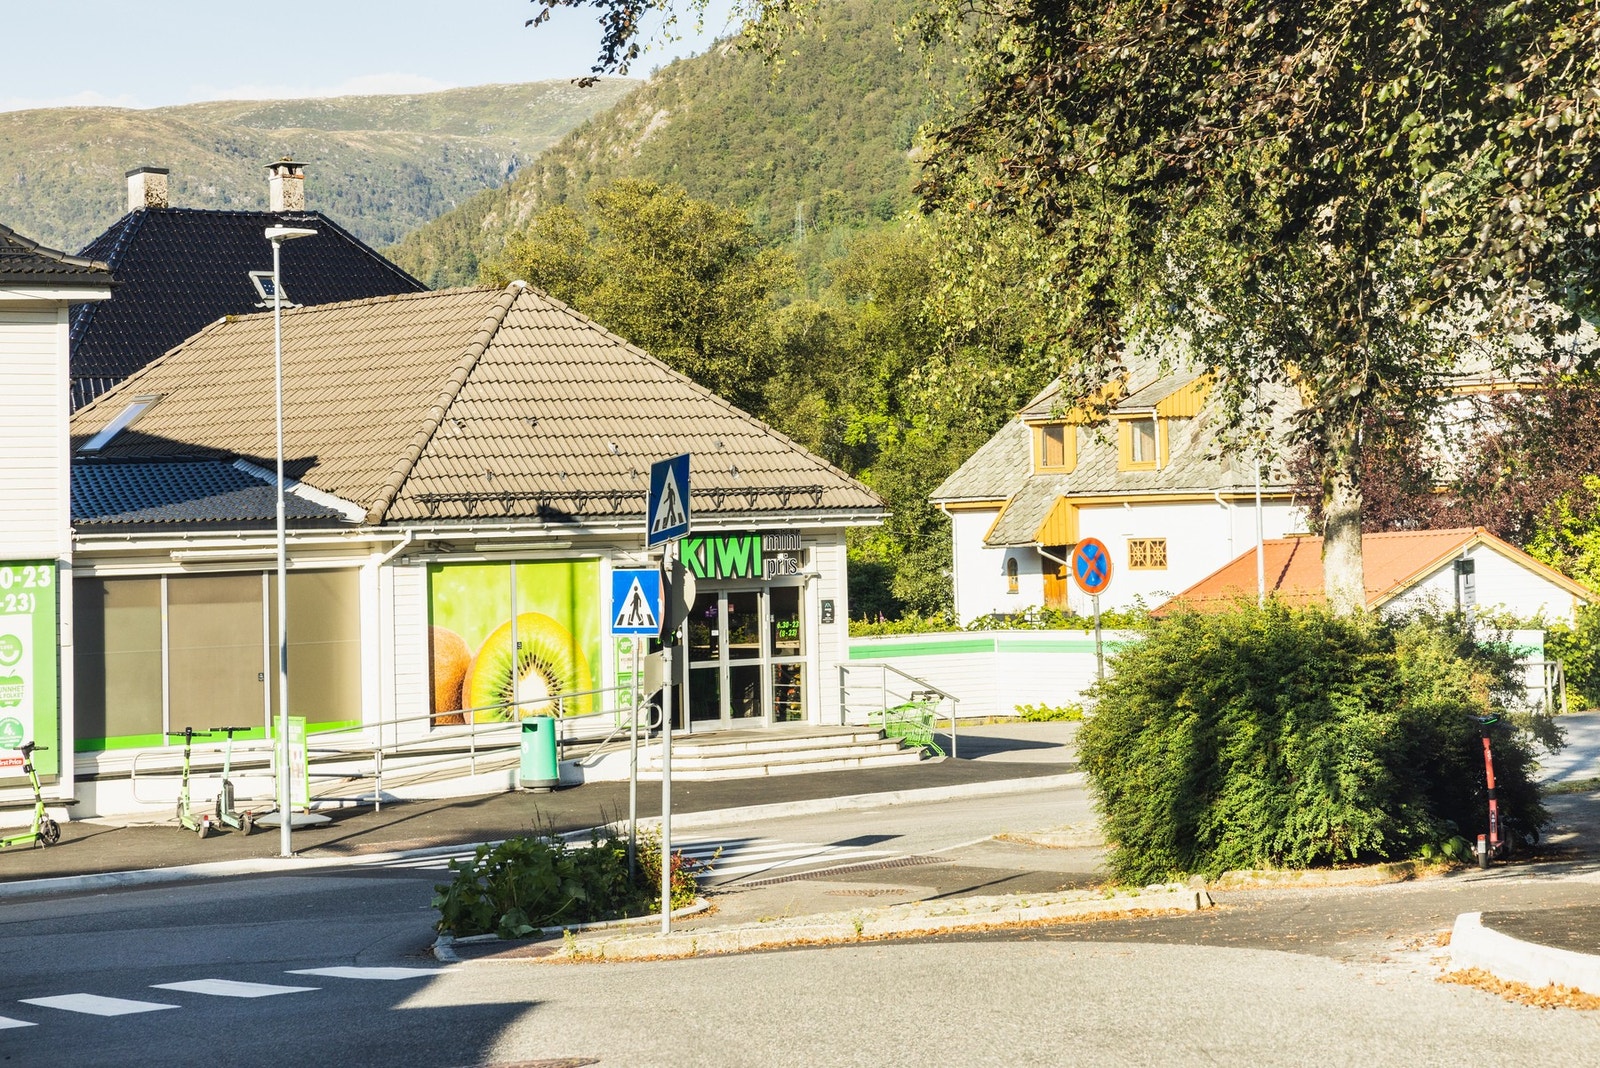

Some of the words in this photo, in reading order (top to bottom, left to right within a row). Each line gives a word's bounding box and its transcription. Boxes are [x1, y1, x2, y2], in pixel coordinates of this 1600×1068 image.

[766, 529, 802, 551] mini
[679, 533, 763, 579] KIWI
[767, 553, 798, 581] pris
